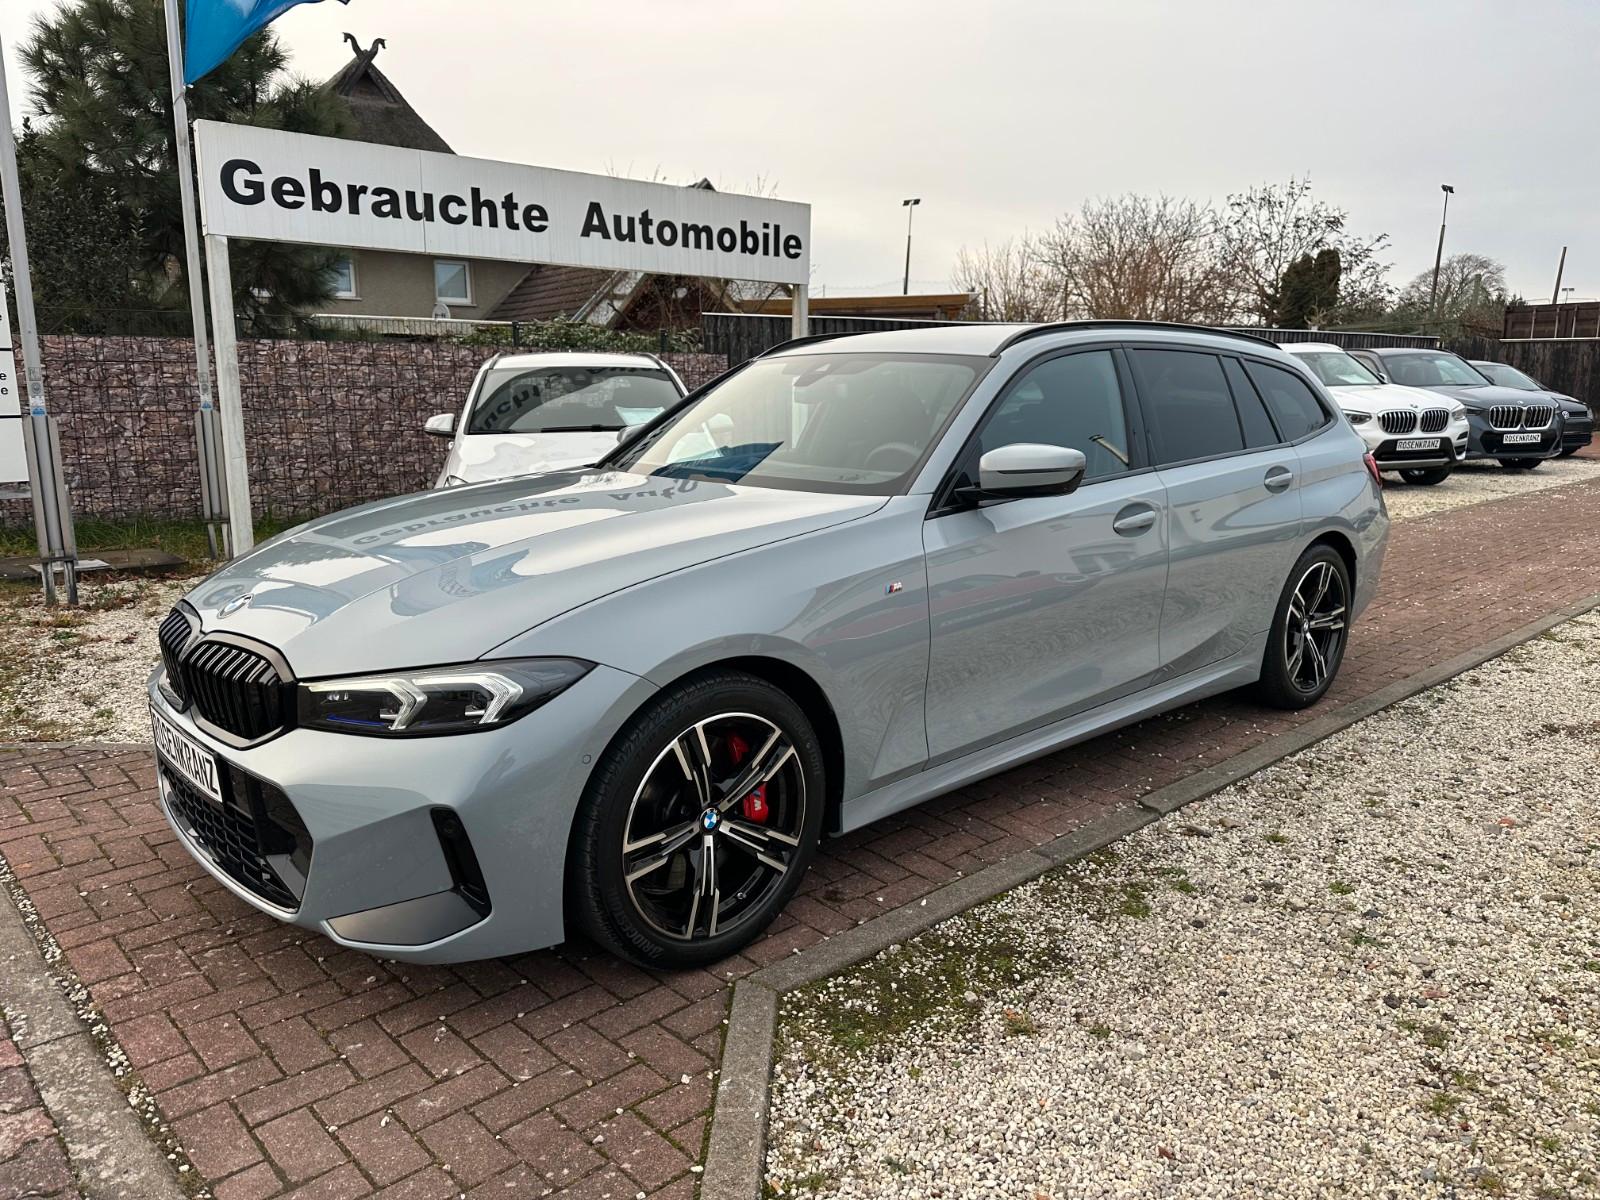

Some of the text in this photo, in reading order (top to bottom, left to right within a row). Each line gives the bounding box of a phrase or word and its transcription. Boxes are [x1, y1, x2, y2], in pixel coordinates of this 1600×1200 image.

[220, 159, 802, 260] Gebrauchte Automobile
[1504, 434, 1540, 443] ROSENKRANZ
[1398, 440, 1439, 450] ROSENKRANZ
